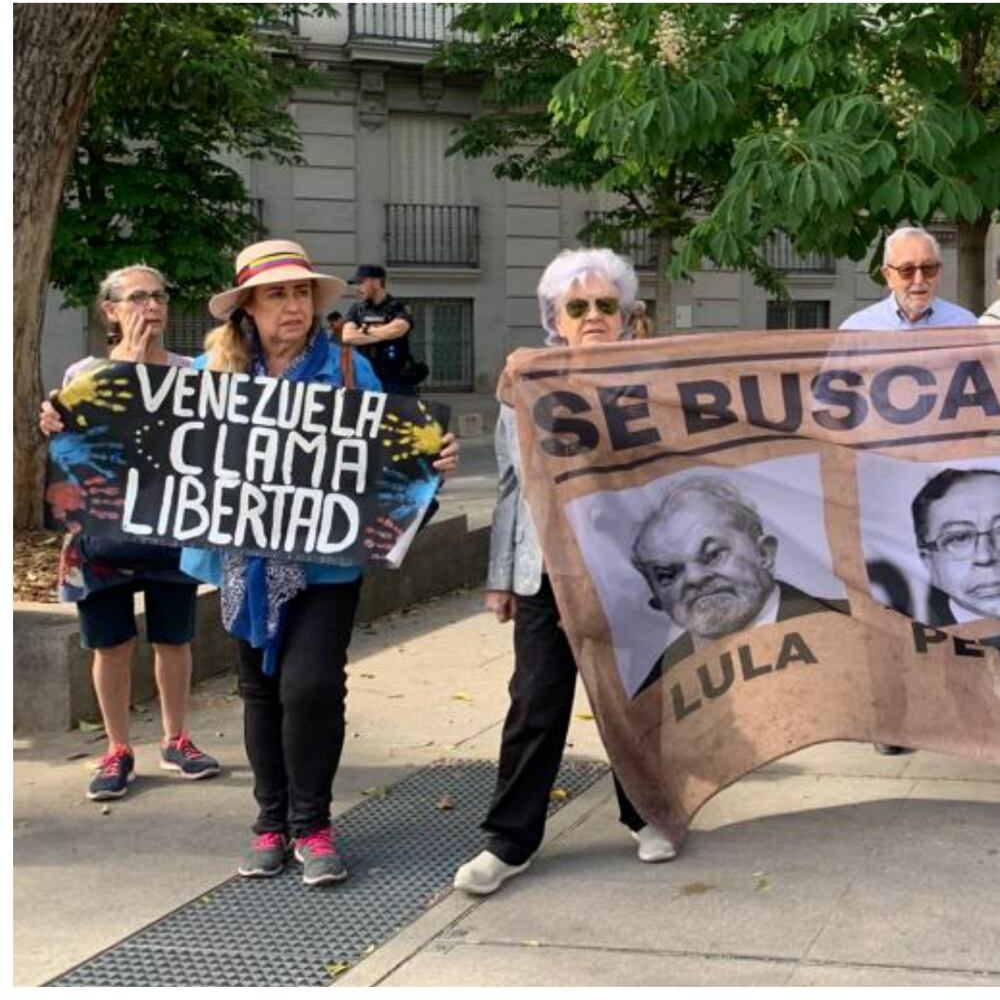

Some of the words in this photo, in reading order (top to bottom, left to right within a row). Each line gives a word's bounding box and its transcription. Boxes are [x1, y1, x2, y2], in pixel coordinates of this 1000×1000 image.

[135, 363, 389, 439] VENEZUELA
[533, 385, 662, 458] SE
[168, 421, 369, 494] CLAMA
[121, 468, 360, 555] LIBERTAD
[670, 631, 818, 722] LULA
